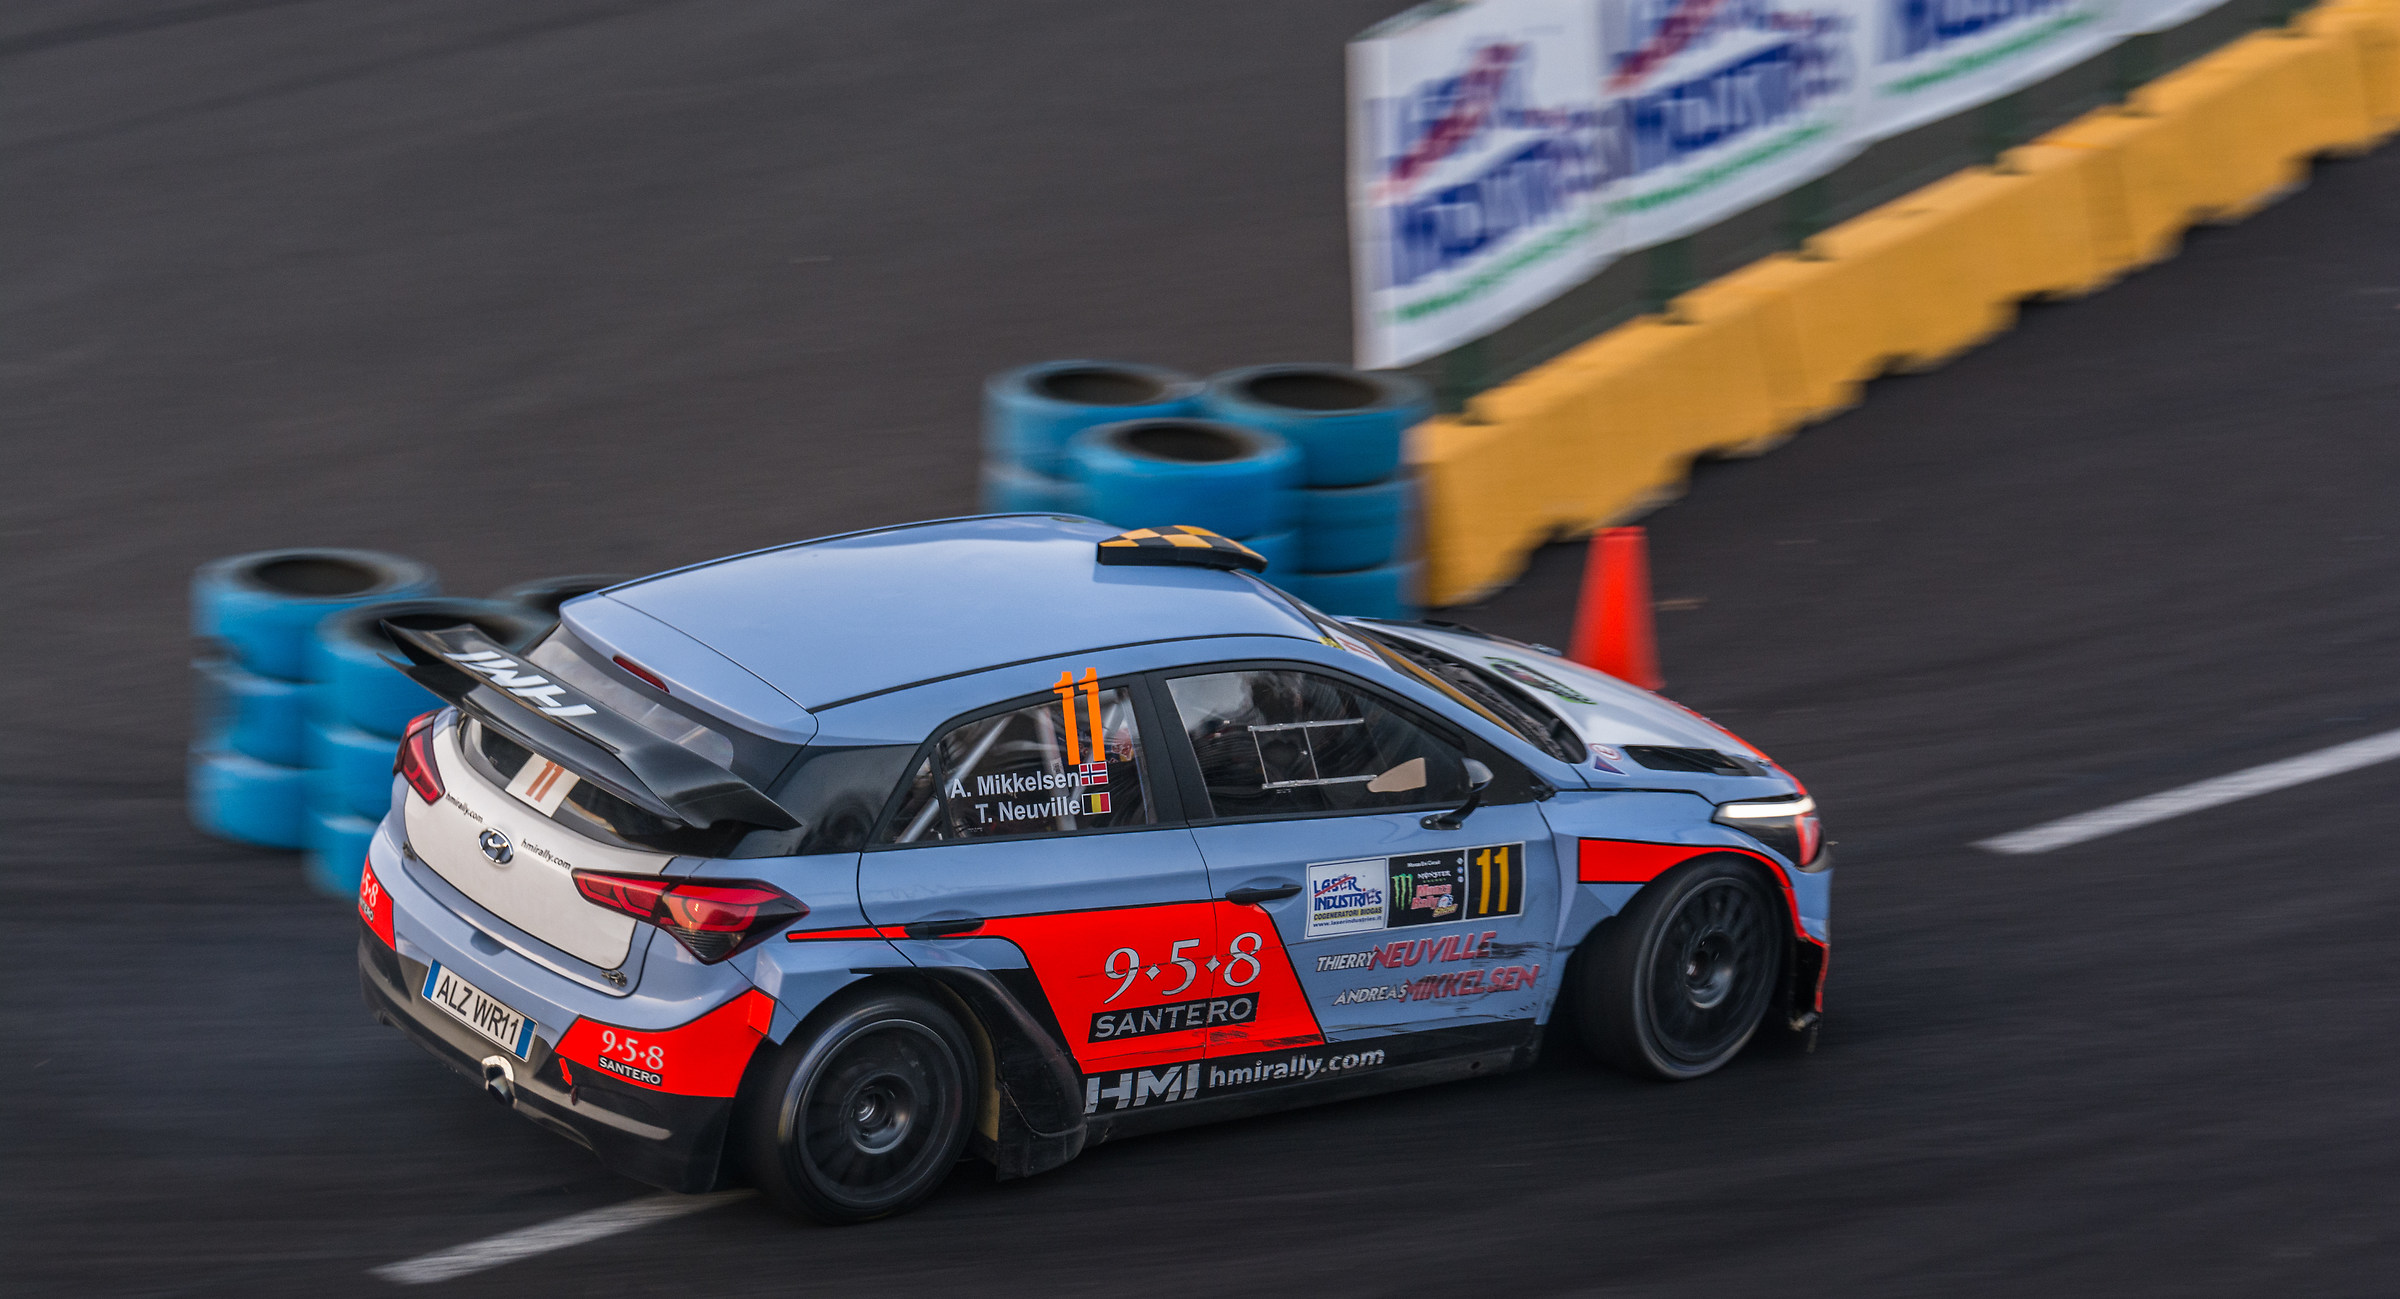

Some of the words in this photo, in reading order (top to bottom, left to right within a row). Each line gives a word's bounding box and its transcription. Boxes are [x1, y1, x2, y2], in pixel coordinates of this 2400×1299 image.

[1053, 667, 1106, 766] 11
[525, 760, 565, 803] 11
[950, 777, 972, 799] A.
[976, 770, 1080, 796] Mikkelsen
[445, 791, 484, 824] hmirally.com
[974, 803, 993, 824] T.
[998, 796, 1081, 822] Neuville
[520, 838, 571, 871] hmirally.com
[1313, 875, 1362, 896] LASER
[1314, 889, 1382, 911] INDUSTRIES
[1476, 846, 1510, 915] 11
[1315, 951, 1378, 973] THIERRY
[1367, 930, 1497, 971] NEUVILLE
[1331, 983, 1407, 1007] ANDREAS
[1399, 964, 1541, 1004] MIKKELSEN
[436, 974, 473, 1017] ALZ
[473, 994, 519, 1045] WR11
[1095, 998, 1253, 1038] SANTERO
[599, 1056, 661, 1085] SANTERO
[1084, 1063, 1200, 1116] HMI
[1208, 1048, 1385, 1089] hmirally.com
